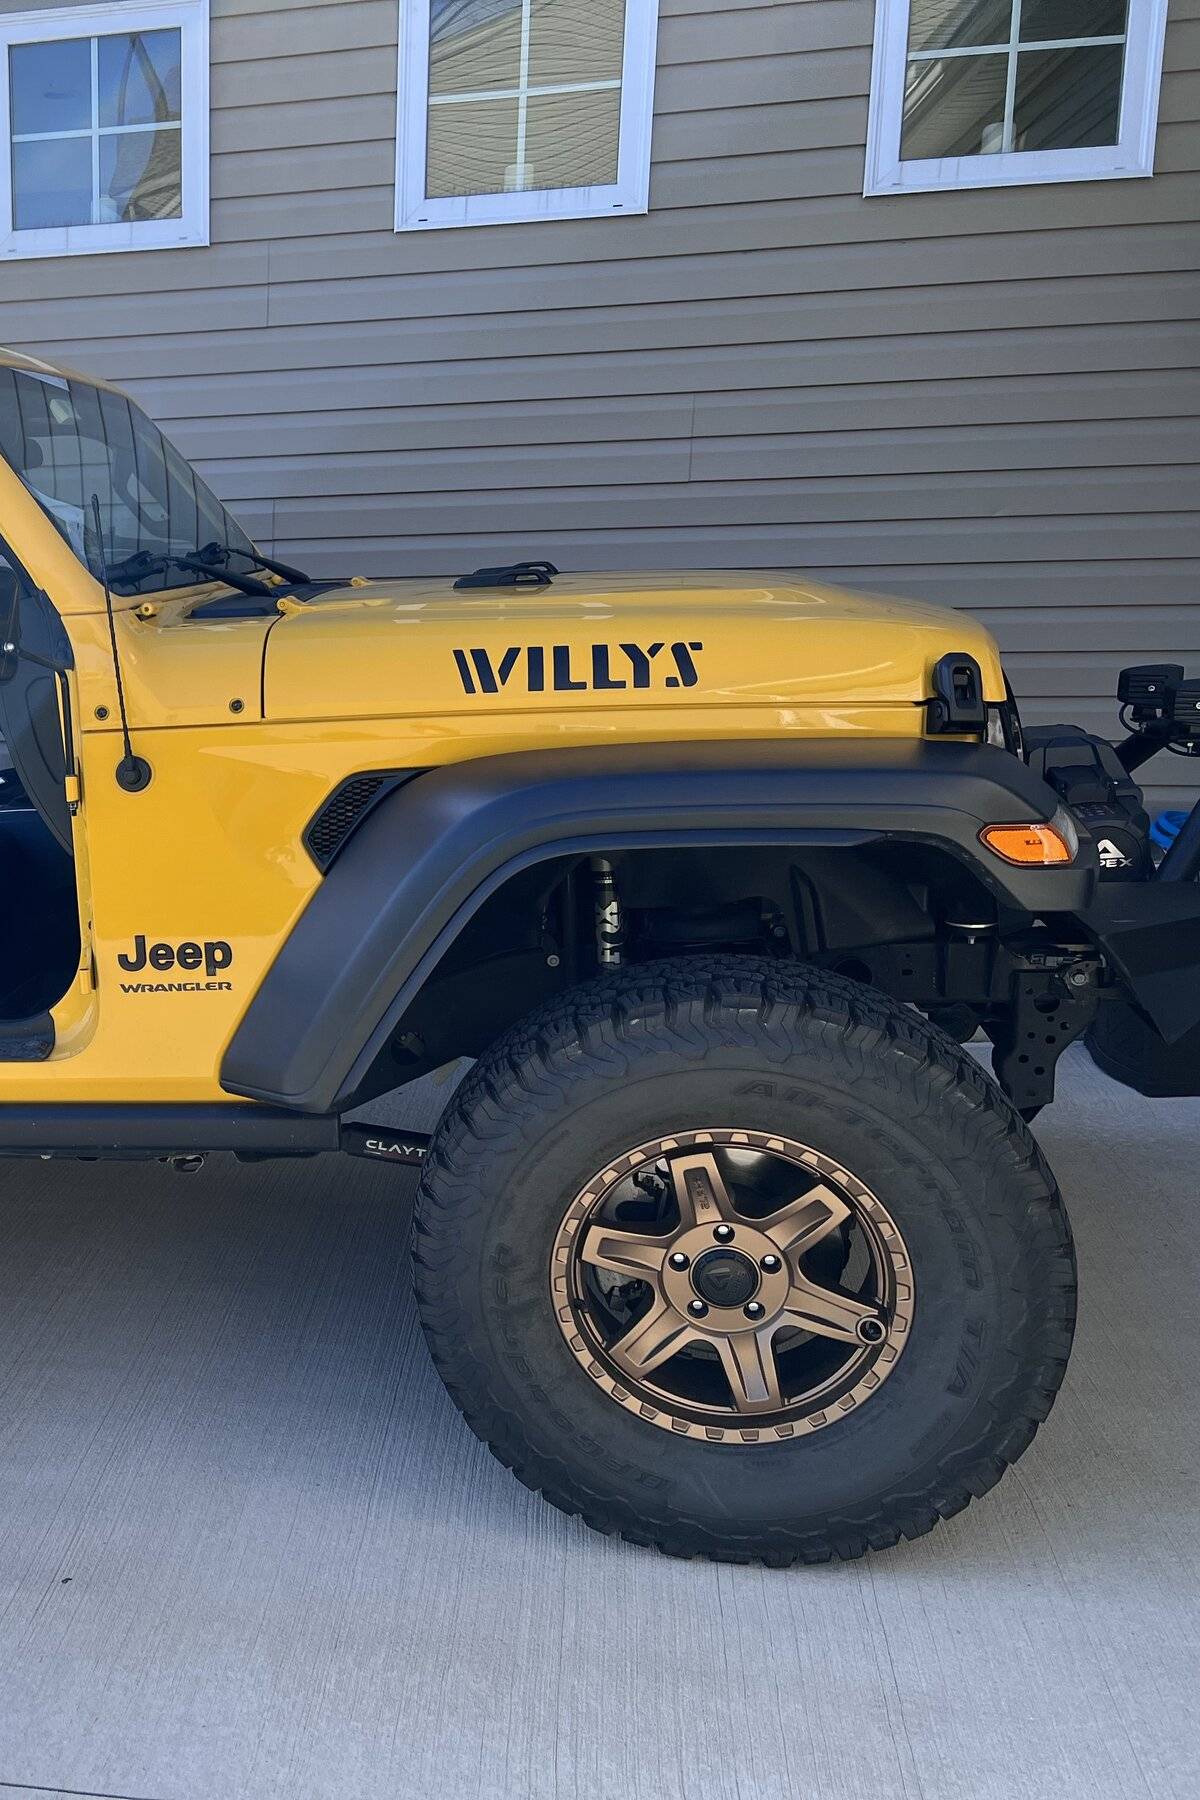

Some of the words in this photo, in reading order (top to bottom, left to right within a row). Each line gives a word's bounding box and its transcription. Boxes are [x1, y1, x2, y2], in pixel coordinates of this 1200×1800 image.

[452, 641, 703, 694] WILLYS
[596, 900, 623, 964] FOX
[117, 934, 233, 977] Jeep
[119, 981, 233, 994] WRANGLER
[365, 1139, 428, 1157] CLAYT
